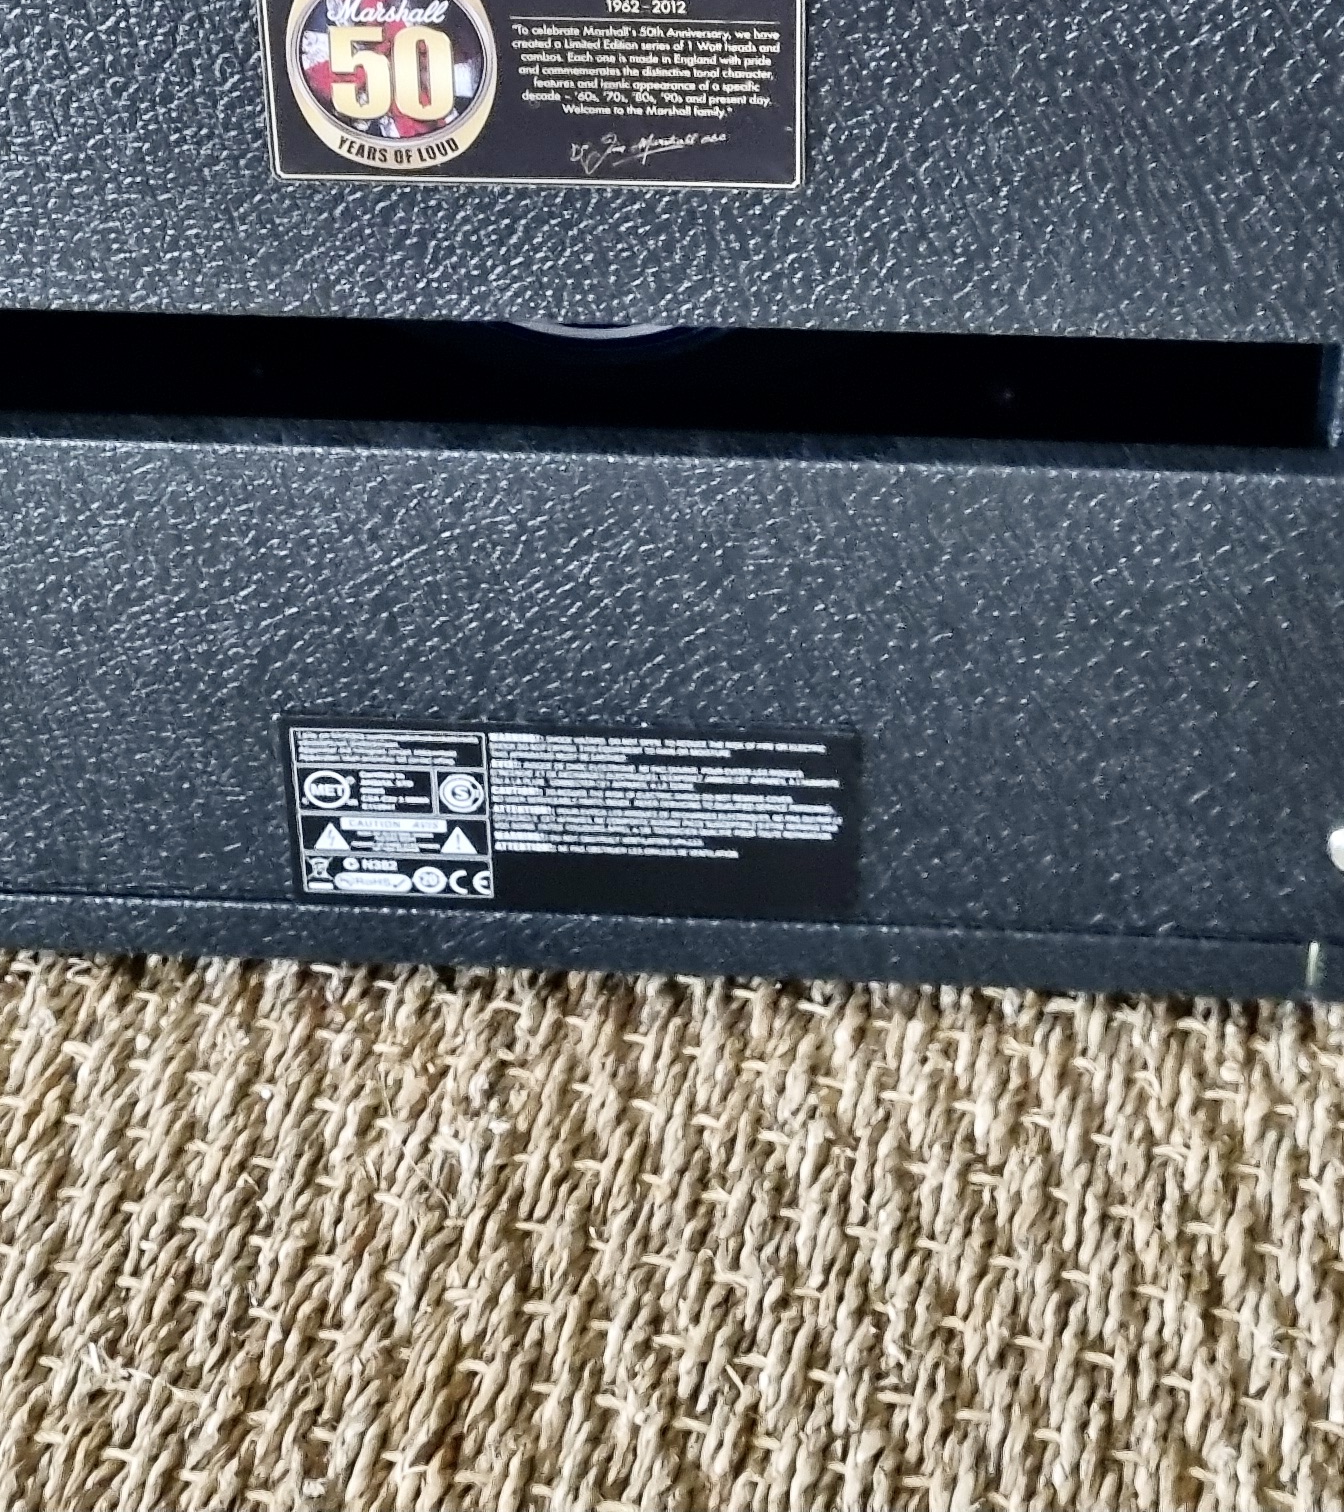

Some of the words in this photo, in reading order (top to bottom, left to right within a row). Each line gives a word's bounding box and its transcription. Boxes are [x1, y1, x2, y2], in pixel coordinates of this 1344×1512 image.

[531, 24, 580, 36] celebrate
[734, 31, 751, 40] we
[753, 28, 781, 40] have
[511, 37, 552, 49] created
[564, 38, 601, 49] Limited
[603, 38, 638, 50] Edition
[640, 40, 670, 51] series
[673, 39, 685, 51] of
[724, 40, 757, 53] heads
[759, 41, 781, 53] and
[566, 51, 593, 63] Each
[595, 54, 616, 63] one
[629, 52, 658, 64] made
[661, 53, 671, 64] in
[673, 53, 716, 66] England
[719, 54, 741, 65] with
[328, 24, 455, 121] 50
[518, 64, 539, 75] and
[622, 65, 640, 76] the
[577, 77, 598, 89] and
[698, 80, 710, 91] of
[685, 93, 706, 104] and
[708, 94, 747, 106] present
[561, 103, 611, 115] Welcome
[613, 105, 624, 115] to
[626, 104, 643, 115] the
[646, 105, 691, 116] Marshall
[337, 135, 388, 163] YEARS
[394, 149, 413, 164] OF
[417, 137, 461, 163] LOUD
[349, 820, 401, 829] CAUTION
